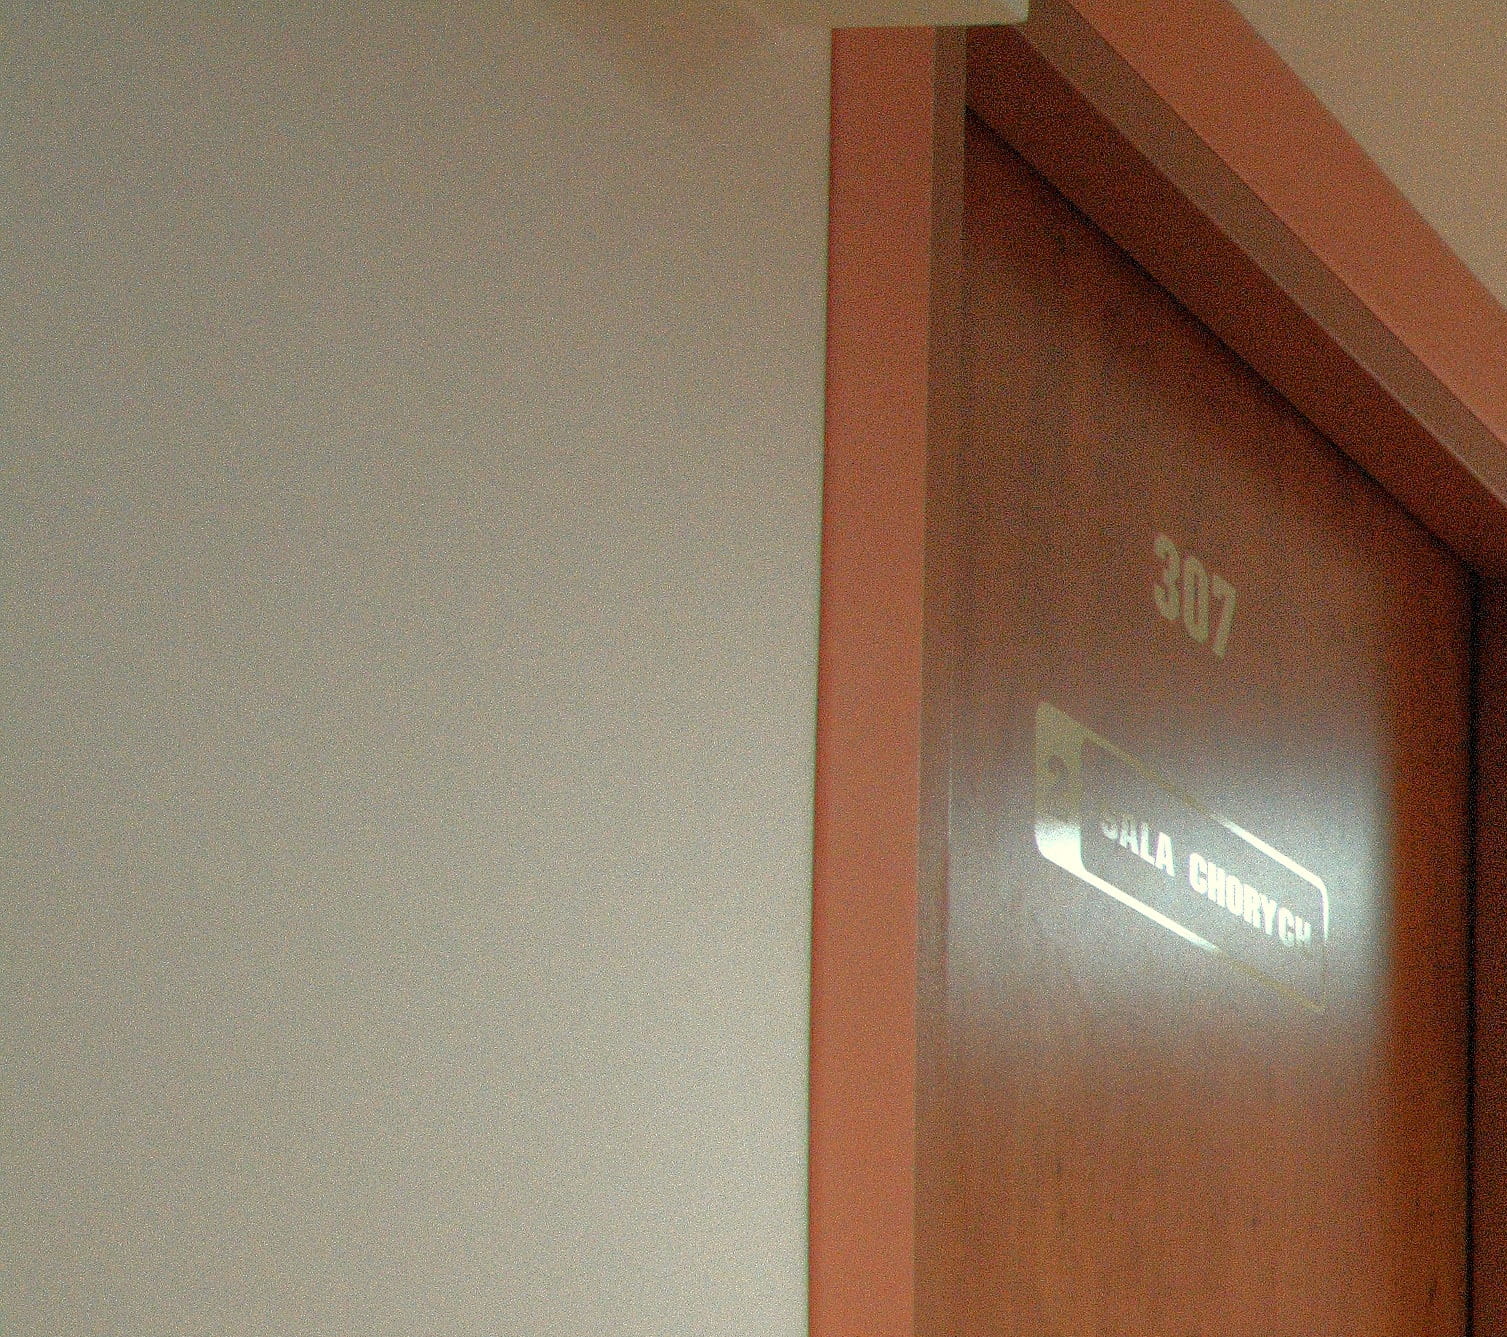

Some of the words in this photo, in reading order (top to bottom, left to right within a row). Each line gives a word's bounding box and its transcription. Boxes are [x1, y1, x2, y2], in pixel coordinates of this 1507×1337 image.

[1154, 534, 1236, 657] 307
[1102, 811, 1175, 876] SALA
[1188, 852, 1312, 950] CHORYCH
